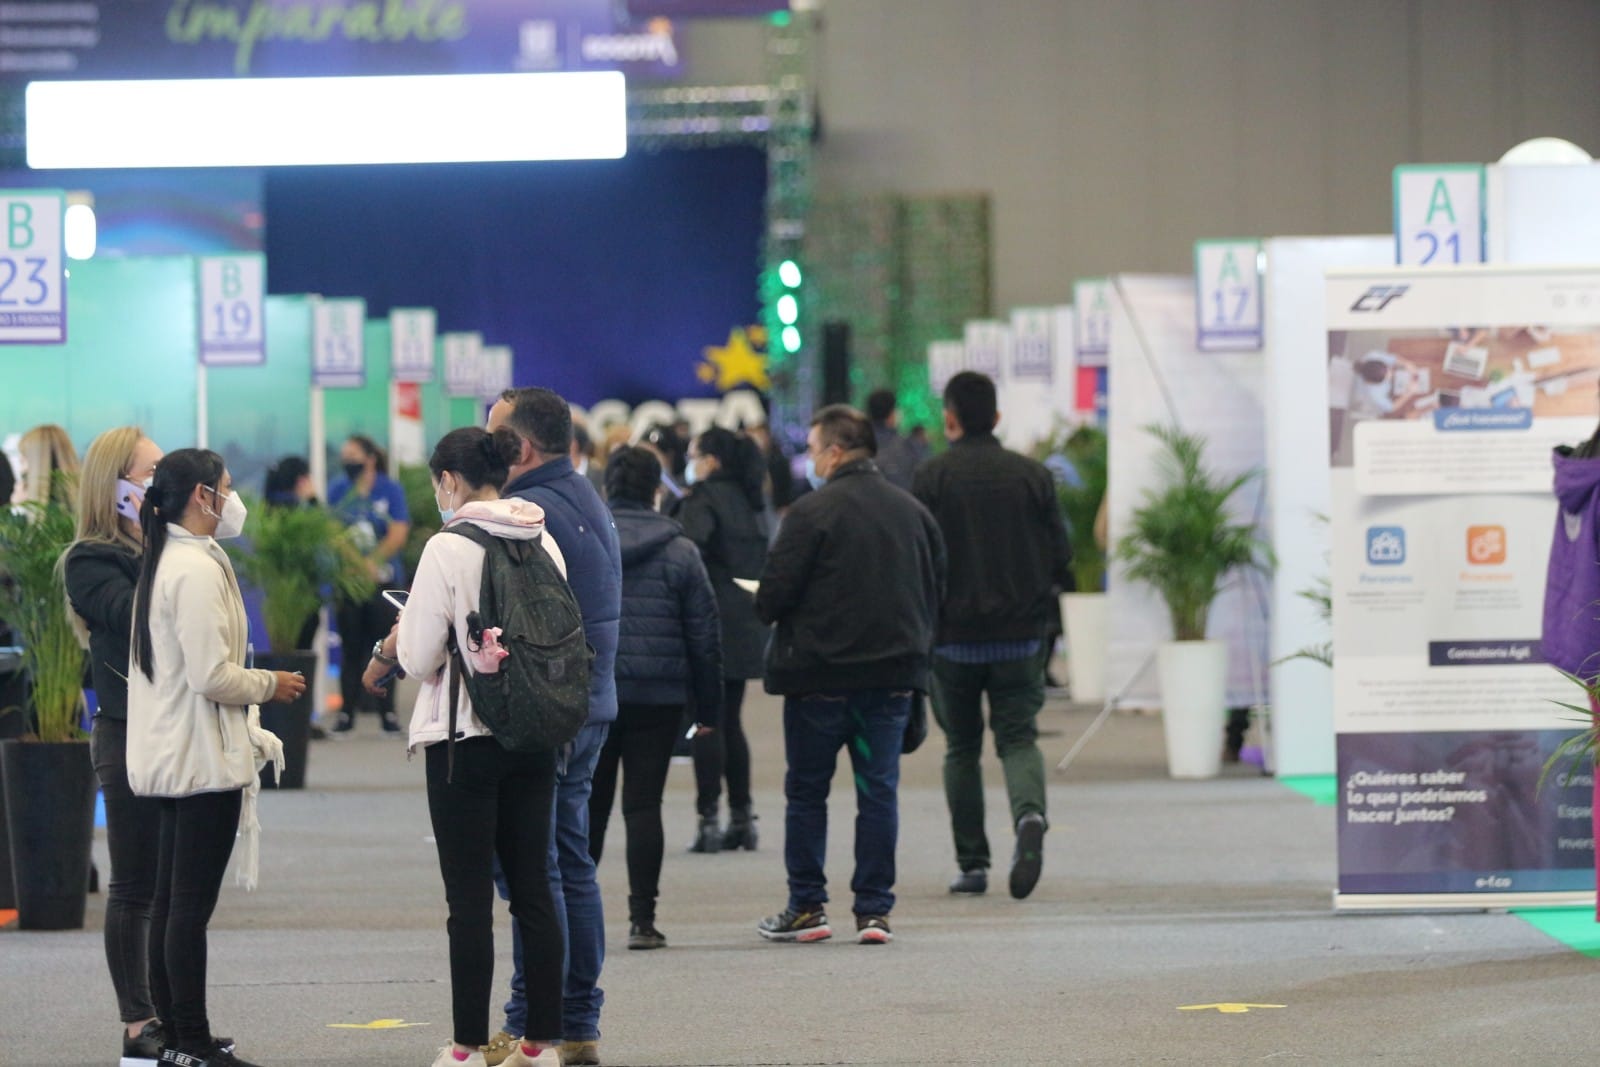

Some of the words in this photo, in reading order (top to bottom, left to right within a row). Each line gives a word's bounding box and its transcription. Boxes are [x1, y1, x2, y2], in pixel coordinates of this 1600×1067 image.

[1426, 176, 1456, 224] A
[8, 201, 35, 249] B
[1414, 229, 1460, 264] 21
[0, 257, 49, 306] 23
[221, 260, 243, 298] B
[1216, 251, 1242, 285] A
[213, 301, 253, 336] 19
[1211, 284, 1248, 323] 17
[1346, 771, 1418, 789] ¿Quieres
[1420, 769, 1466, 784] saber
[1347, 808, 1394, 824] hacer
[1394, 807, 1455, 826] juntos?
[1366, 792, 1398, 808] que
